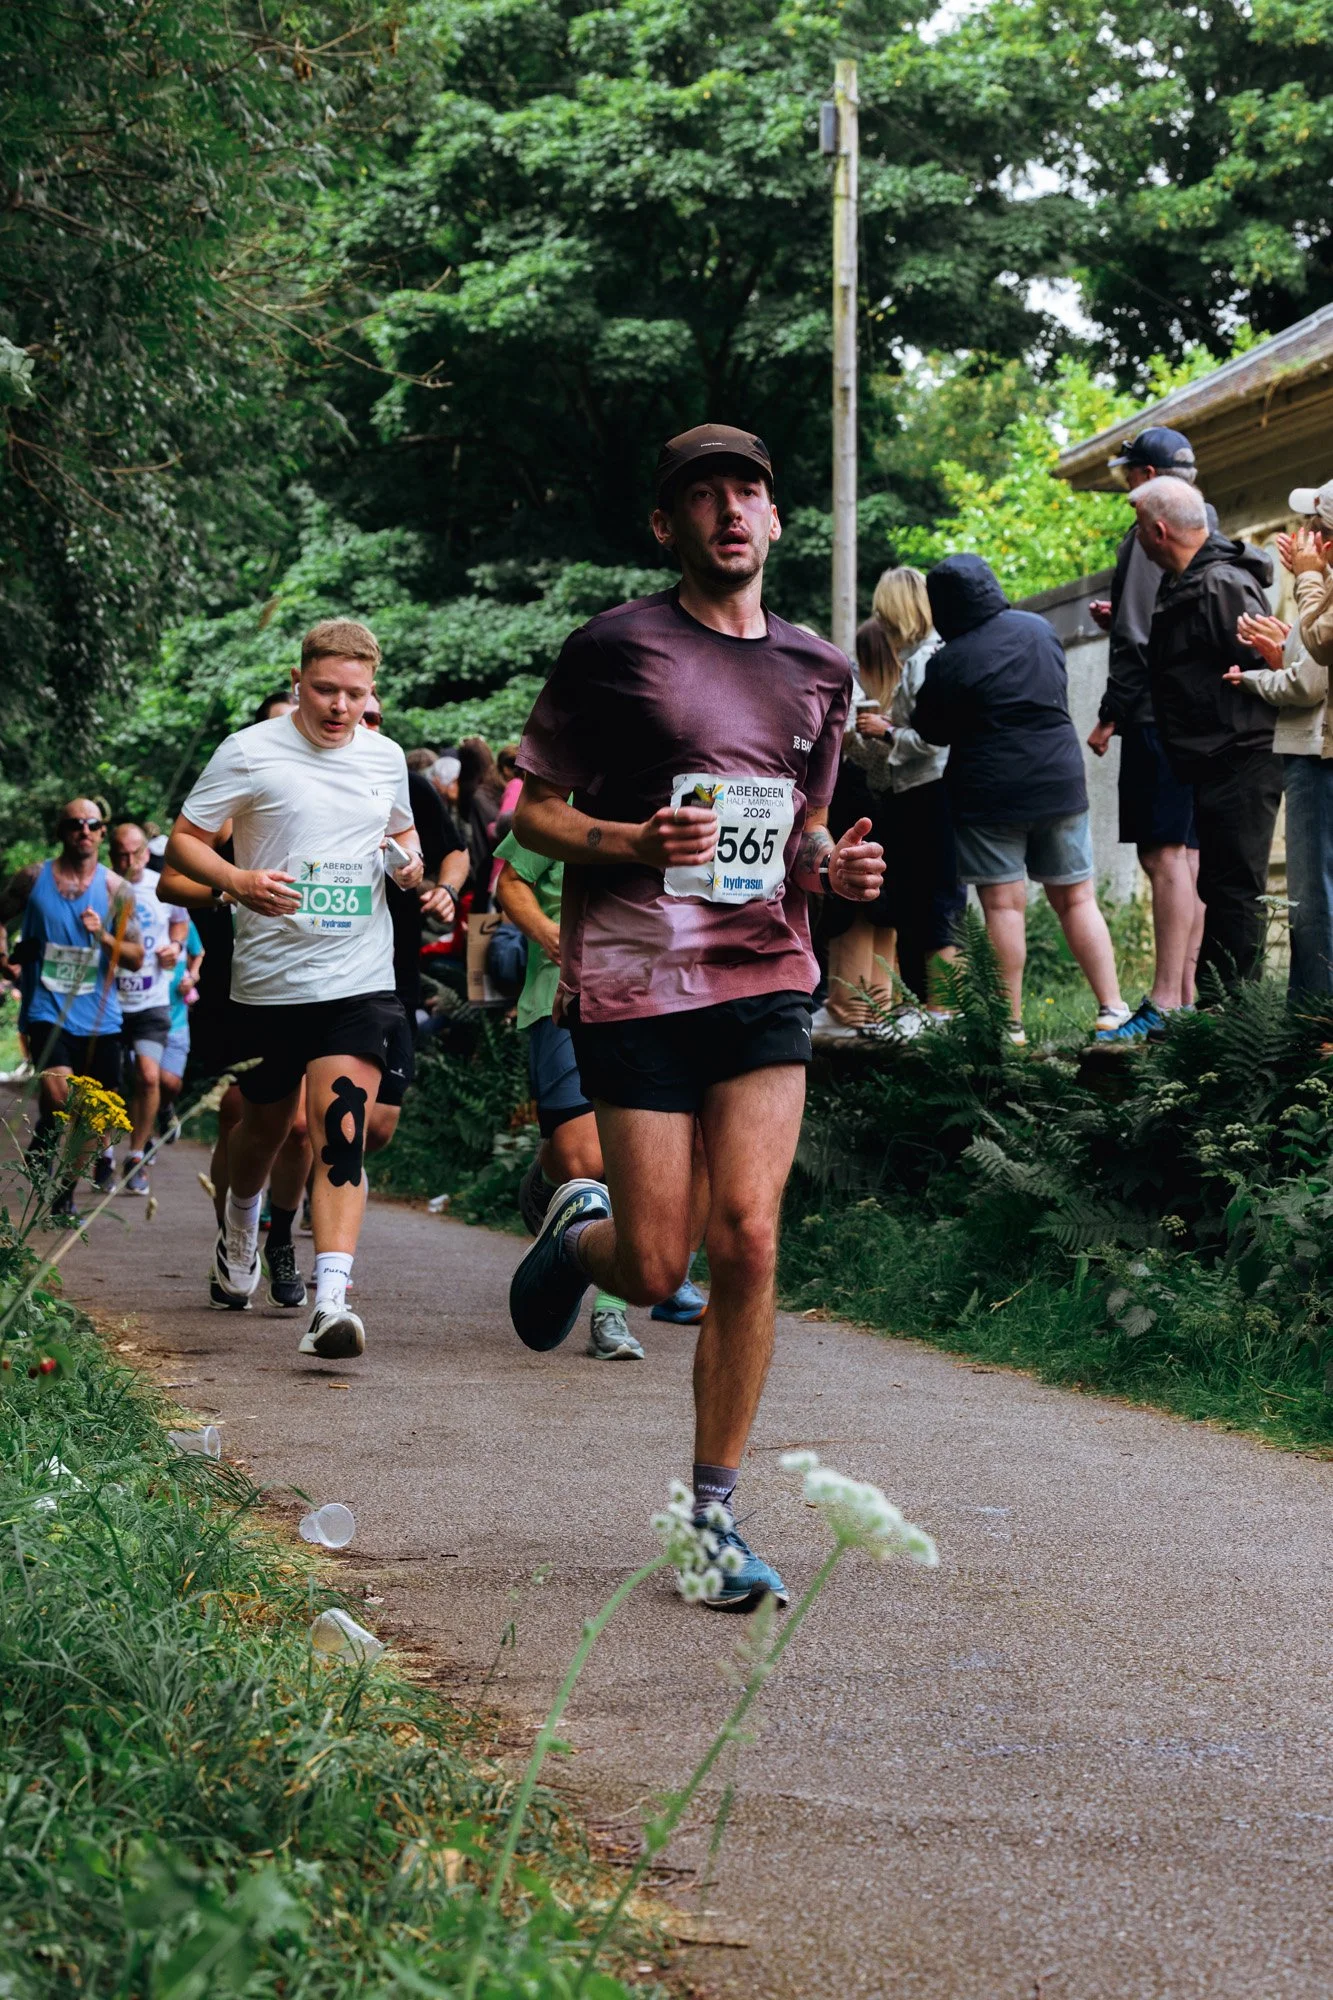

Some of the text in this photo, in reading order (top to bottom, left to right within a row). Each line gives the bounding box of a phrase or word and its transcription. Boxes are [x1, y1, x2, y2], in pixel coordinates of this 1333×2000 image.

[727, 785, 784, 798] ABERDEEN
[726, 797, 784, 808] HALF MARATHON
[743, 807, 771, 819] 2026
[717, 826, 779, 865] 565
[302, 886, 360, 914] 1036
